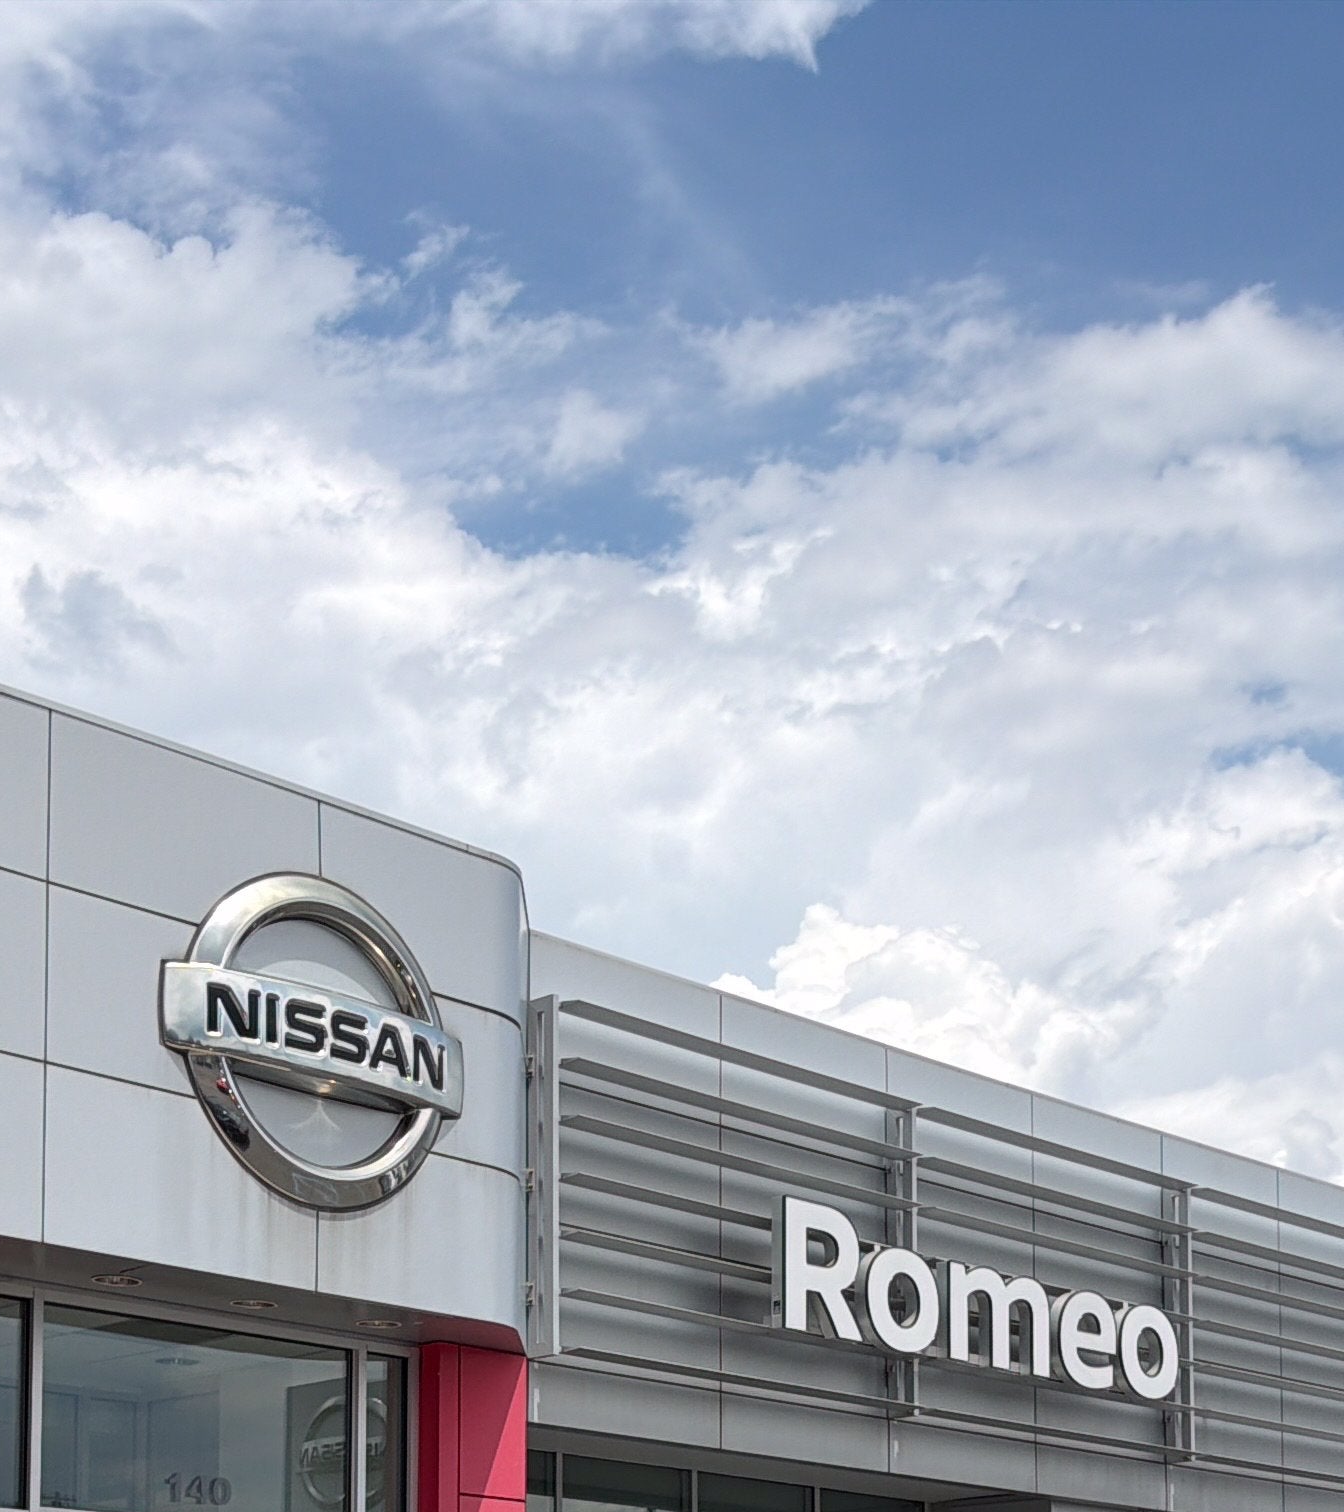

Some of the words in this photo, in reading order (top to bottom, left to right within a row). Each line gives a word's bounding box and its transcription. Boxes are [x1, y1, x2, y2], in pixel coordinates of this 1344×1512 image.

[206, 982, 446, 1094] NISSAN
[780, 1194, 1179, 1400] Romeo
[164, 1472, 232, 1506] 140
